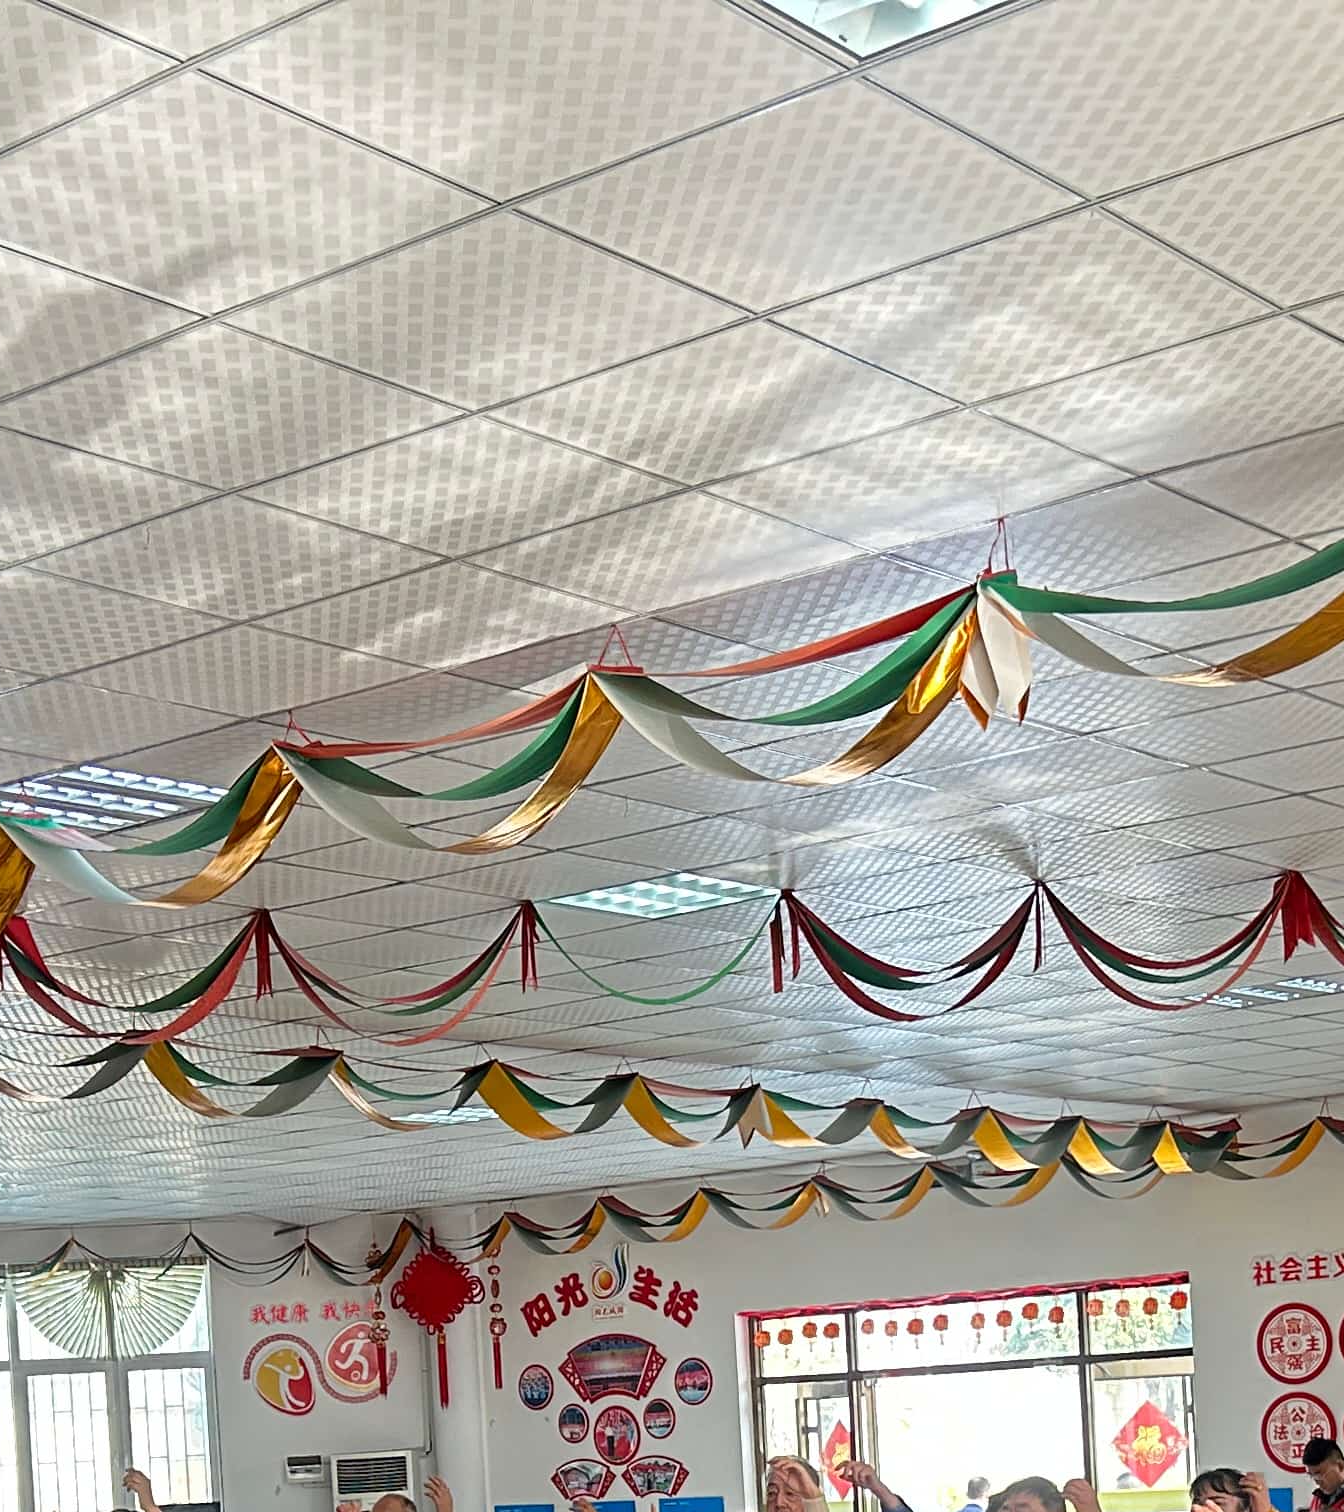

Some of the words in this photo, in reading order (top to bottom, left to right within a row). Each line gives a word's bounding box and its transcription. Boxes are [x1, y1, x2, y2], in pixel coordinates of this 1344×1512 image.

[250, 1303, 309, 1324] 我健康
[521, 1273, 589, 1337] 阳光
[629, 1265, 699, 1327] 生活
